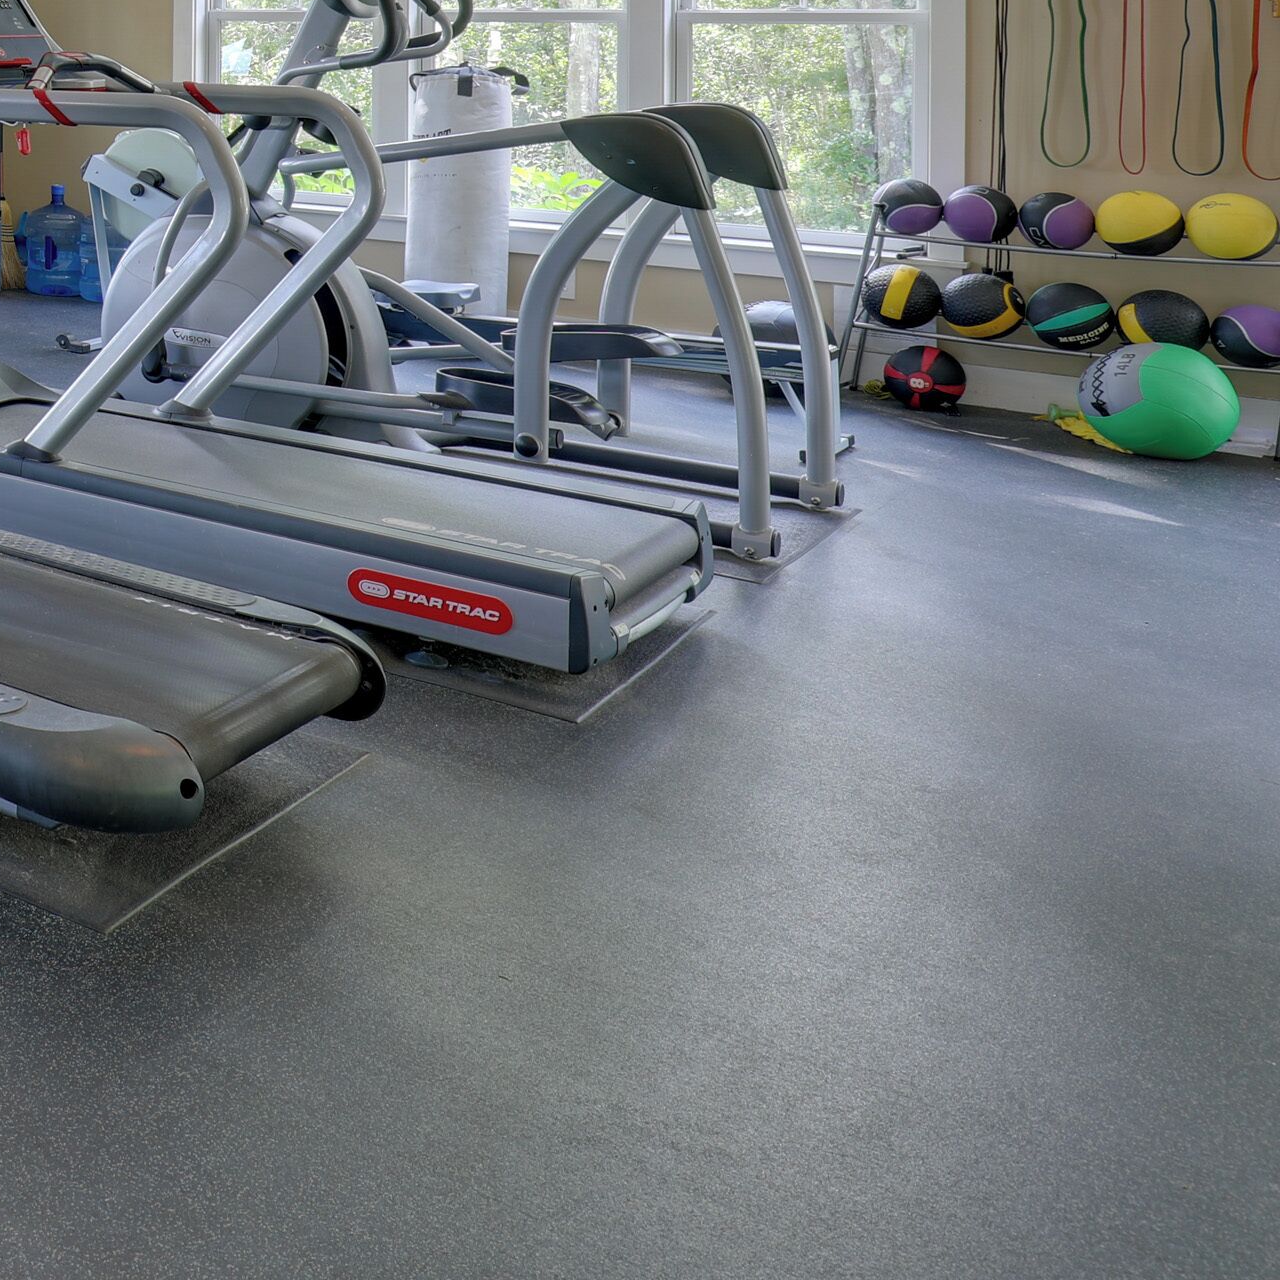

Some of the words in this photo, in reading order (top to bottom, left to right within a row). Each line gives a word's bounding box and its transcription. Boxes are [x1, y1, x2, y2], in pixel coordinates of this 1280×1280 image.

[180, 334, 211, 345] VISION
[1057, 321, 1109, 343] MEDICINE
[1080, 336, 1100, 345] BALL
[1114, 353, 1136, 377] 14LB
[393, 589, 443, 609] STAR
[446, 600, 500, 622] TRAC
